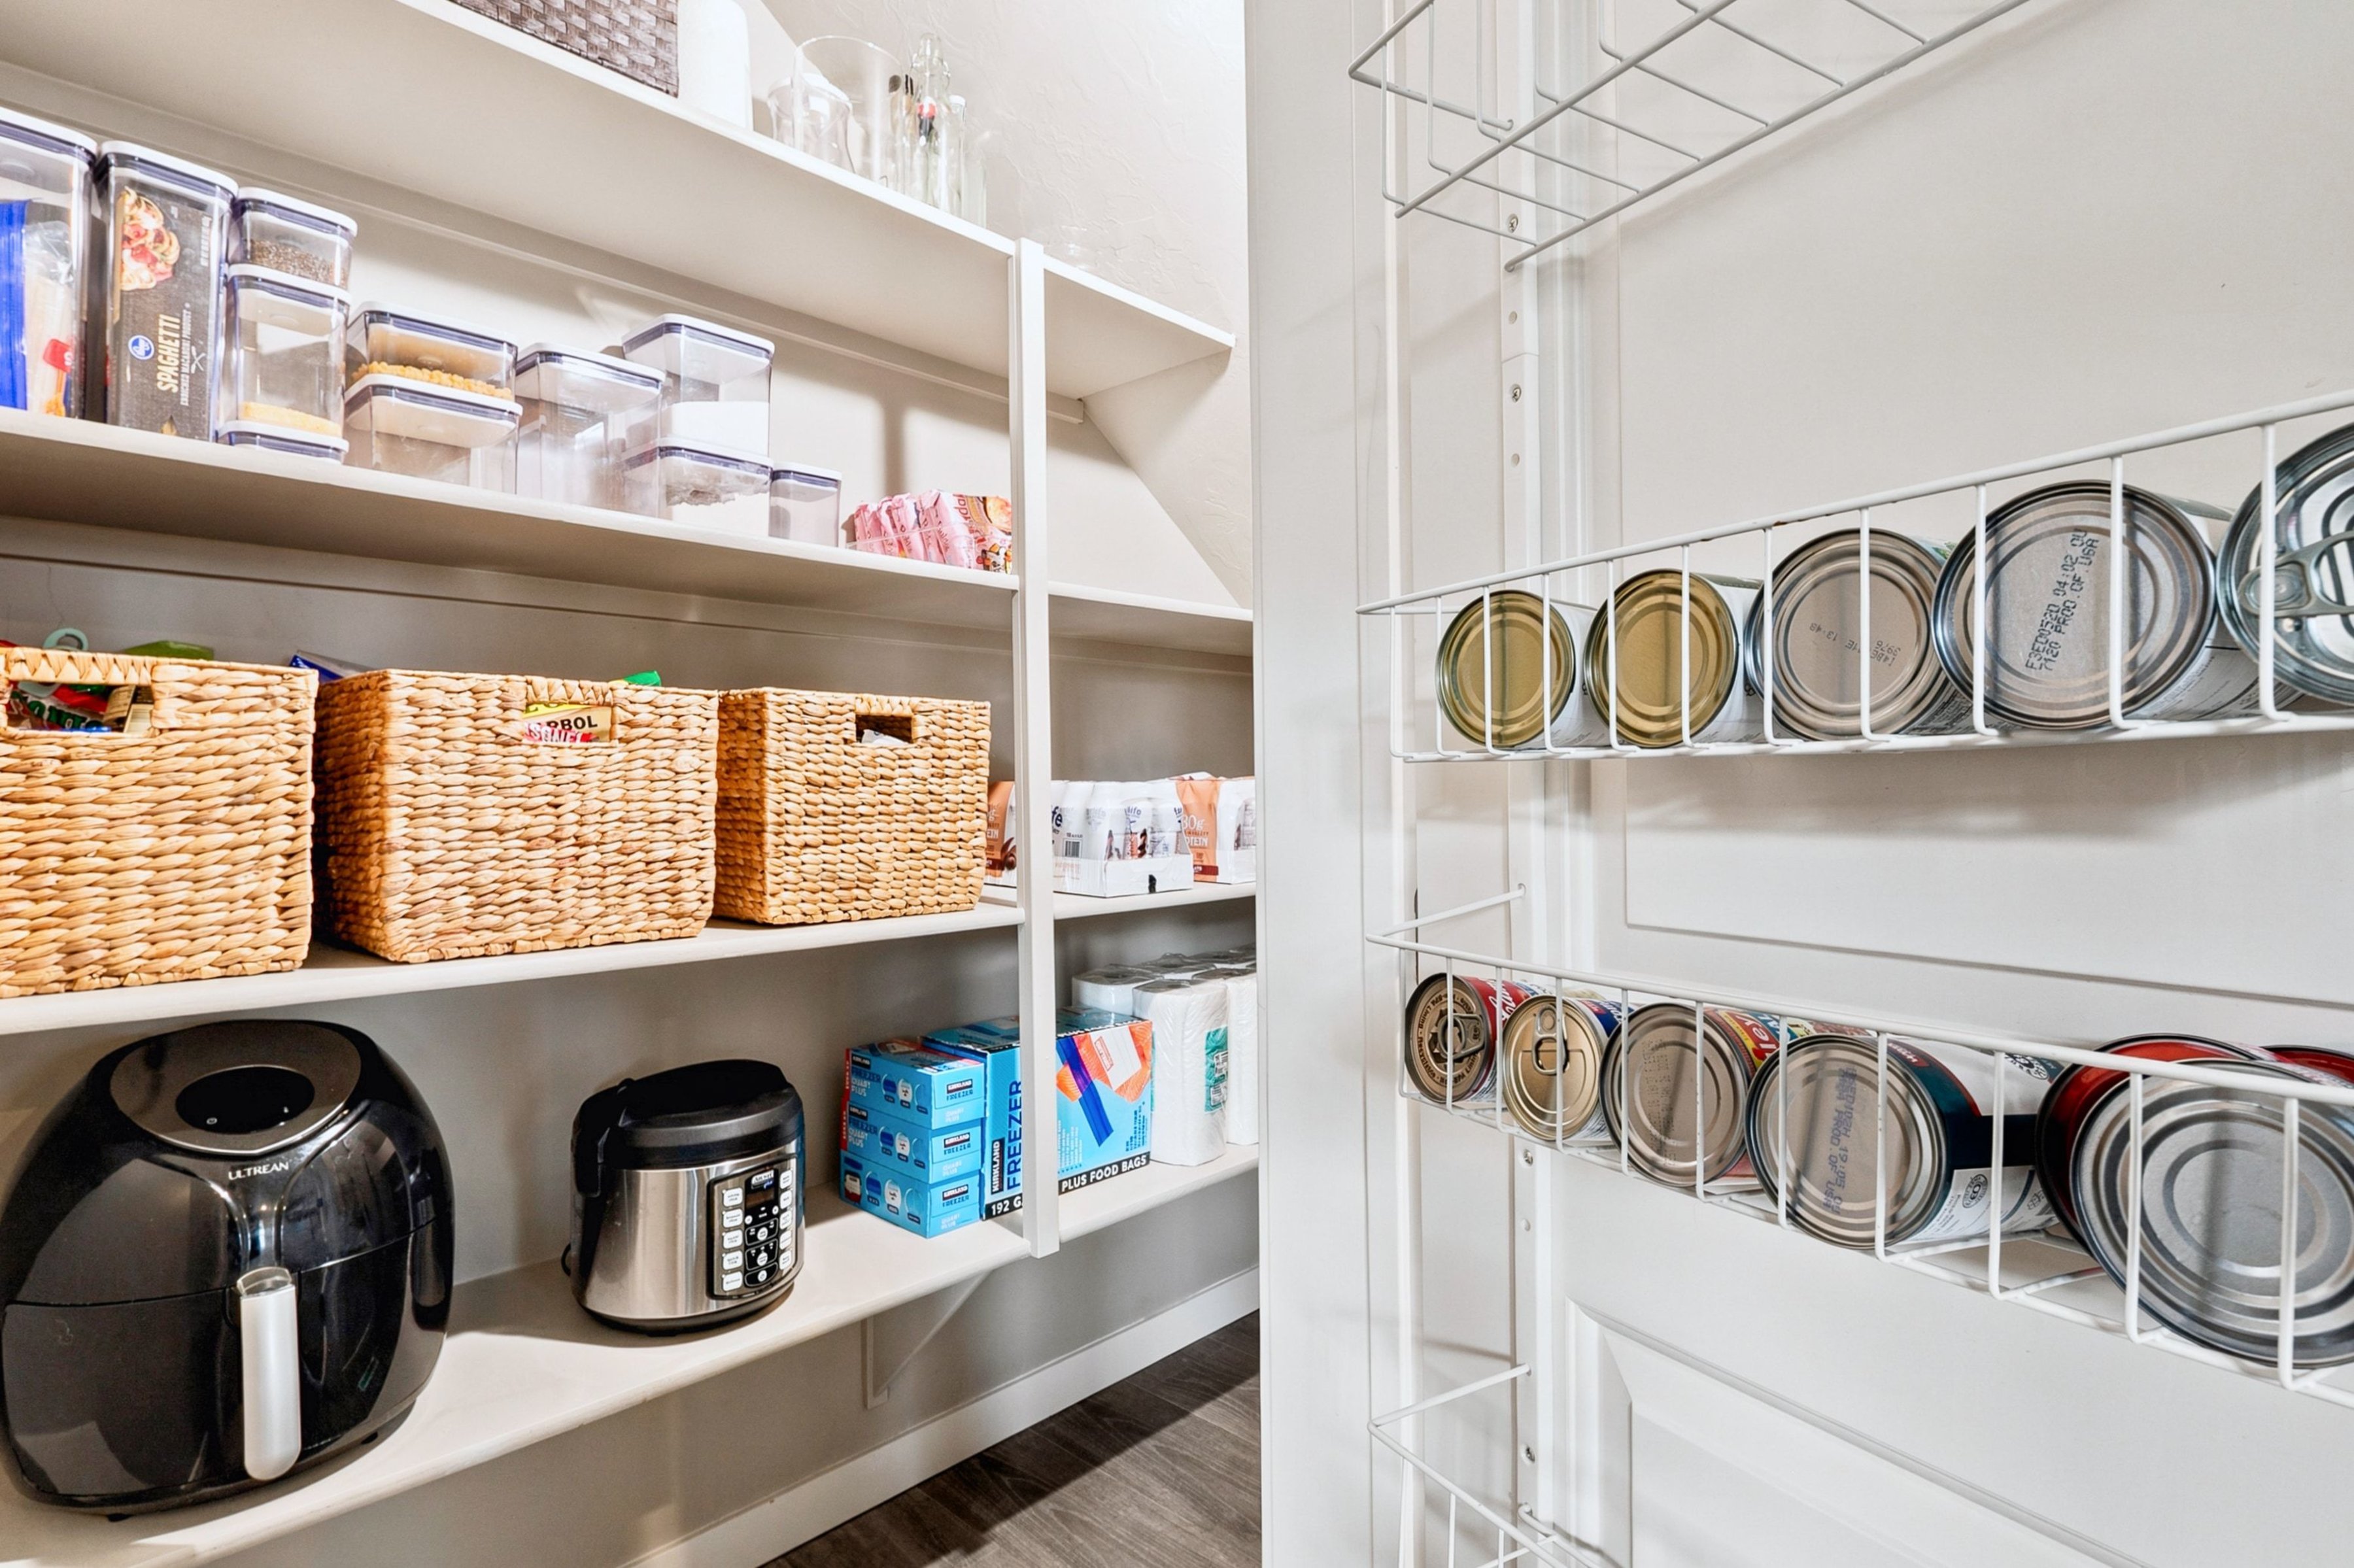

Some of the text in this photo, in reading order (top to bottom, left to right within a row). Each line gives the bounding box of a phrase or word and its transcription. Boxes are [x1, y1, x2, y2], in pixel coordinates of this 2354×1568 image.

[157, 314, 180, 393] SPAGHETTI
[536, 715, 598, 731] RBOL
[1186, 837, 1208, 846] OTEIN
[1007, 1080, 1021, 1190] FREEZER
[228, 1162, 289, 1180] ULTREAN
[991, 1155, 1147, 1216] 192 G PLUS FOOD BAGS
[992, 1140, 1000, 1193] KIRKLAND
